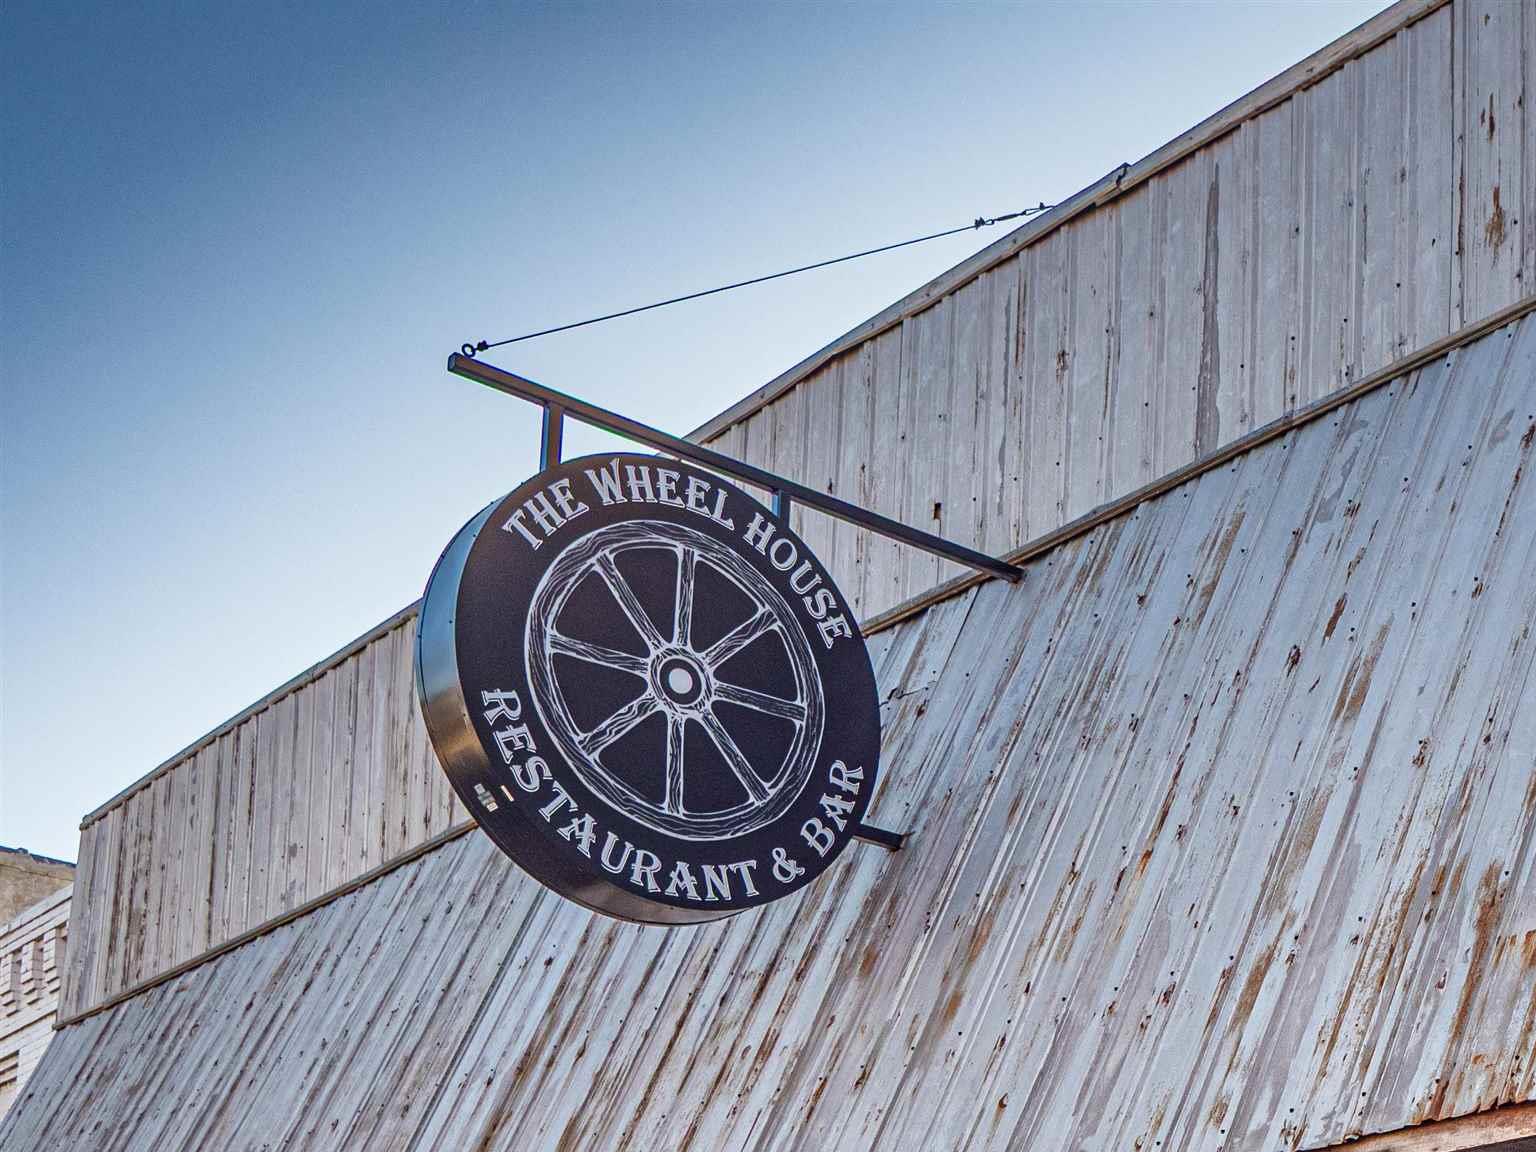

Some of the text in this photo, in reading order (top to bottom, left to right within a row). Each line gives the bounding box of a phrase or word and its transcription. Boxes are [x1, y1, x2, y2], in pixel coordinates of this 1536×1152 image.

[502, 457, 853, 650] THE WHEEL HOUSE
[480, 688, 865, 902] RESTAURANT & BAR
